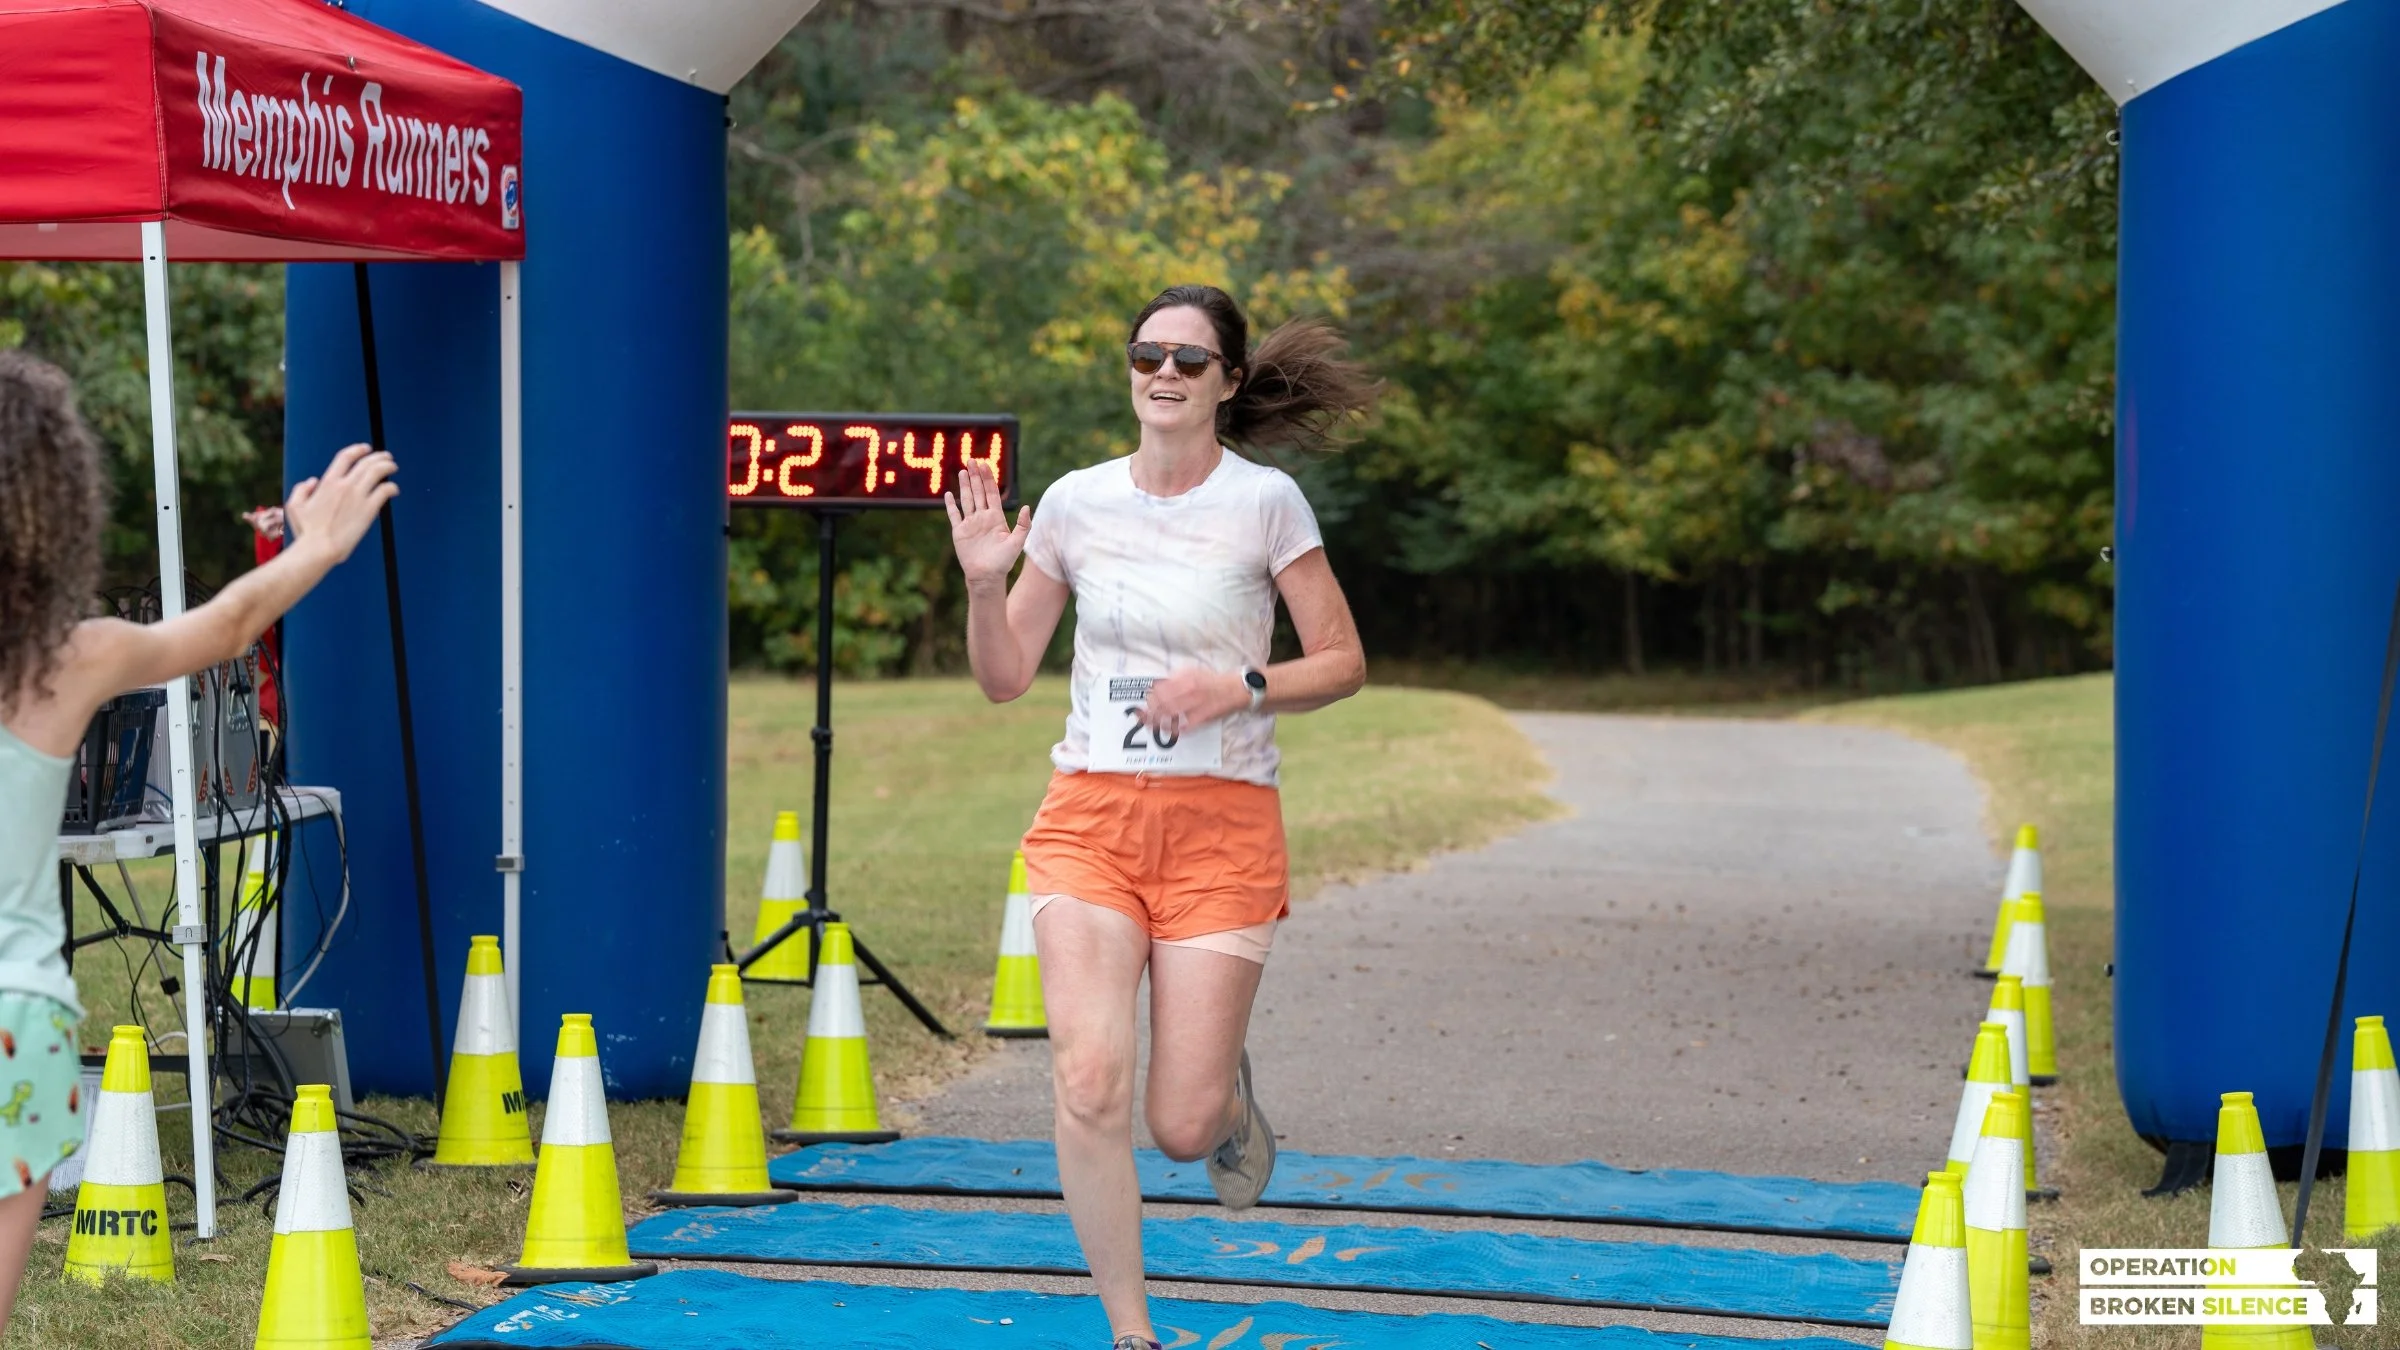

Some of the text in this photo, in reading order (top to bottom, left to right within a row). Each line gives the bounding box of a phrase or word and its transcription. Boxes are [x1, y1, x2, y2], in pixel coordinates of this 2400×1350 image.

[196, 51, 491, 210] Memphis Runners
[1122, 705, 1179, 749] 20
[76, 1209, 158, 1236] MRTC
